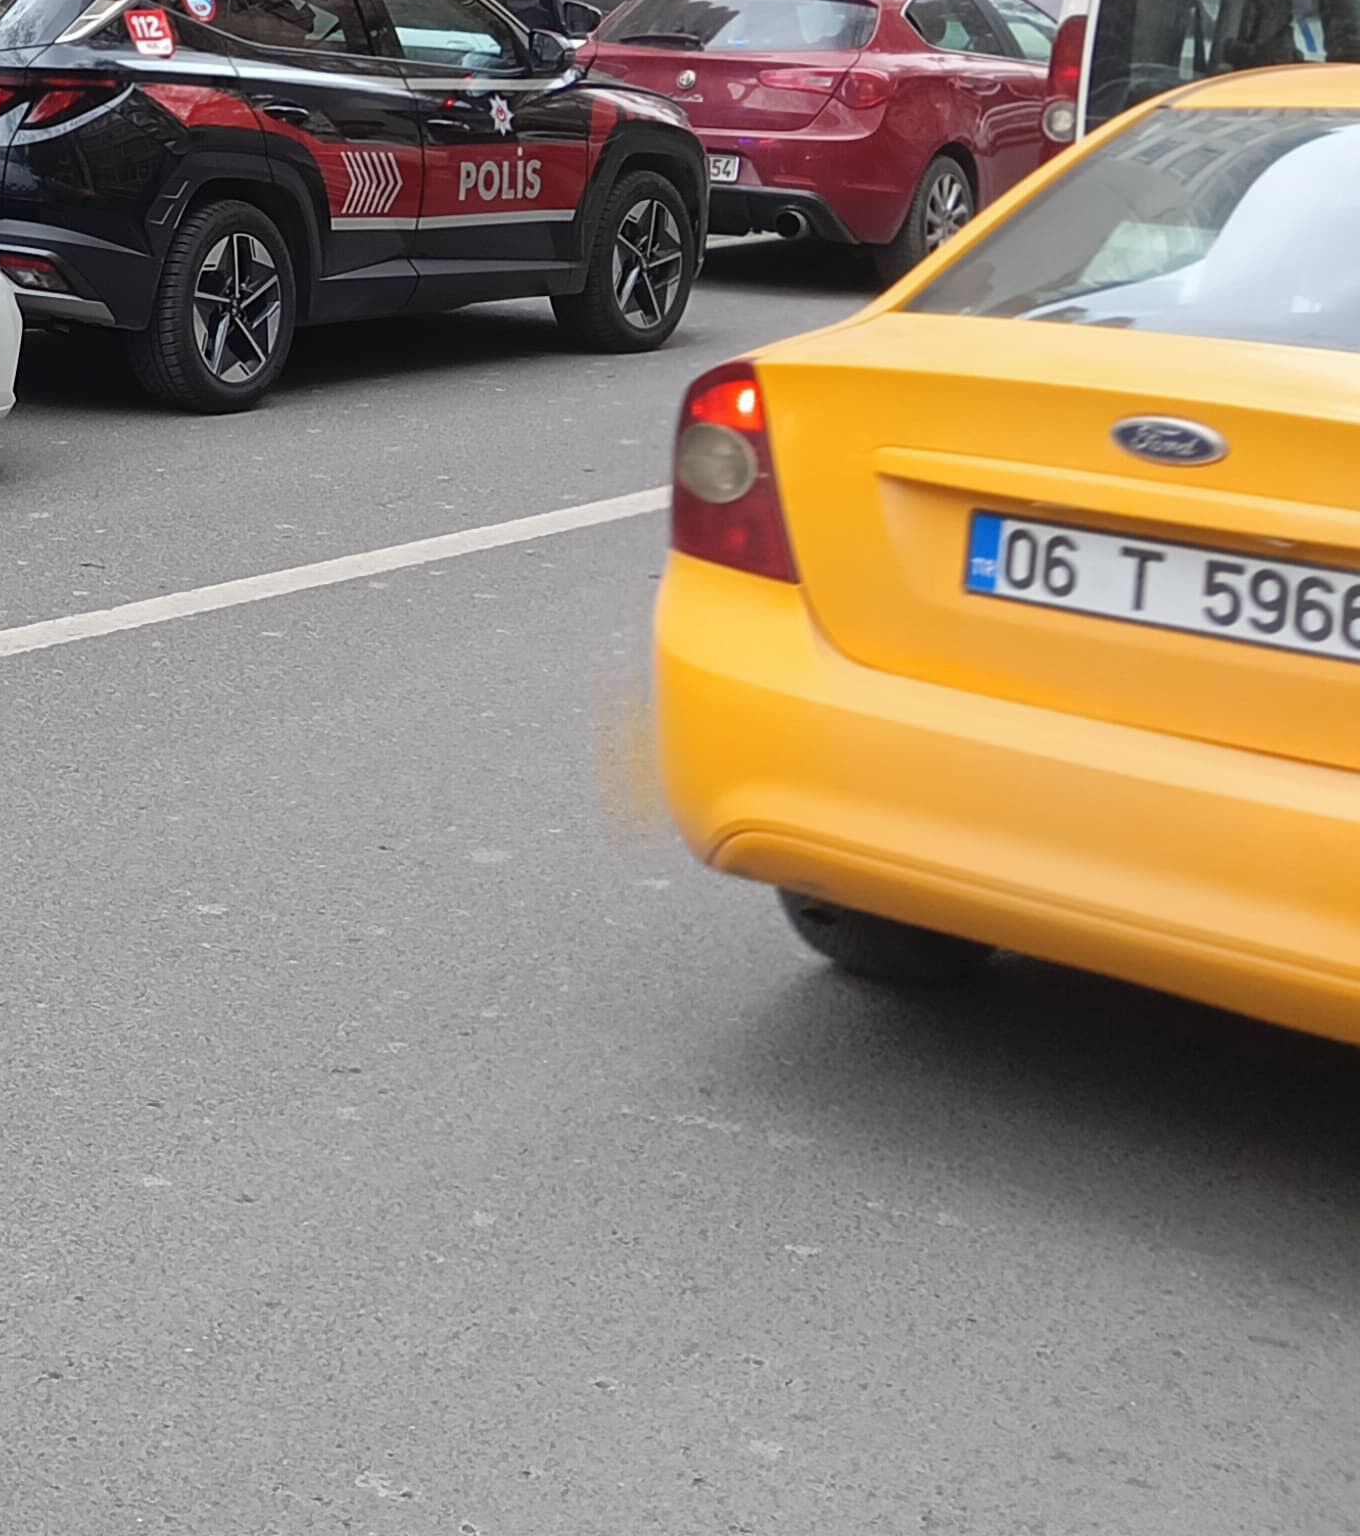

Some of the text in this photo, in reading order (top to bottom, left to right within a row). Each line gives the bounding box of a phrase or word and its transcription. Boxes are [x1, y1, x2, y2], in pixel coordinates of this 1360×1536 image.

[131, 15, 164, 38] 112
[458, 146, 542, 201] POLİS
[1130, 424, 1199, 458] Ford
[1004, 527, 1078, 598] 06
[1119, 545, 1167, 612] T
